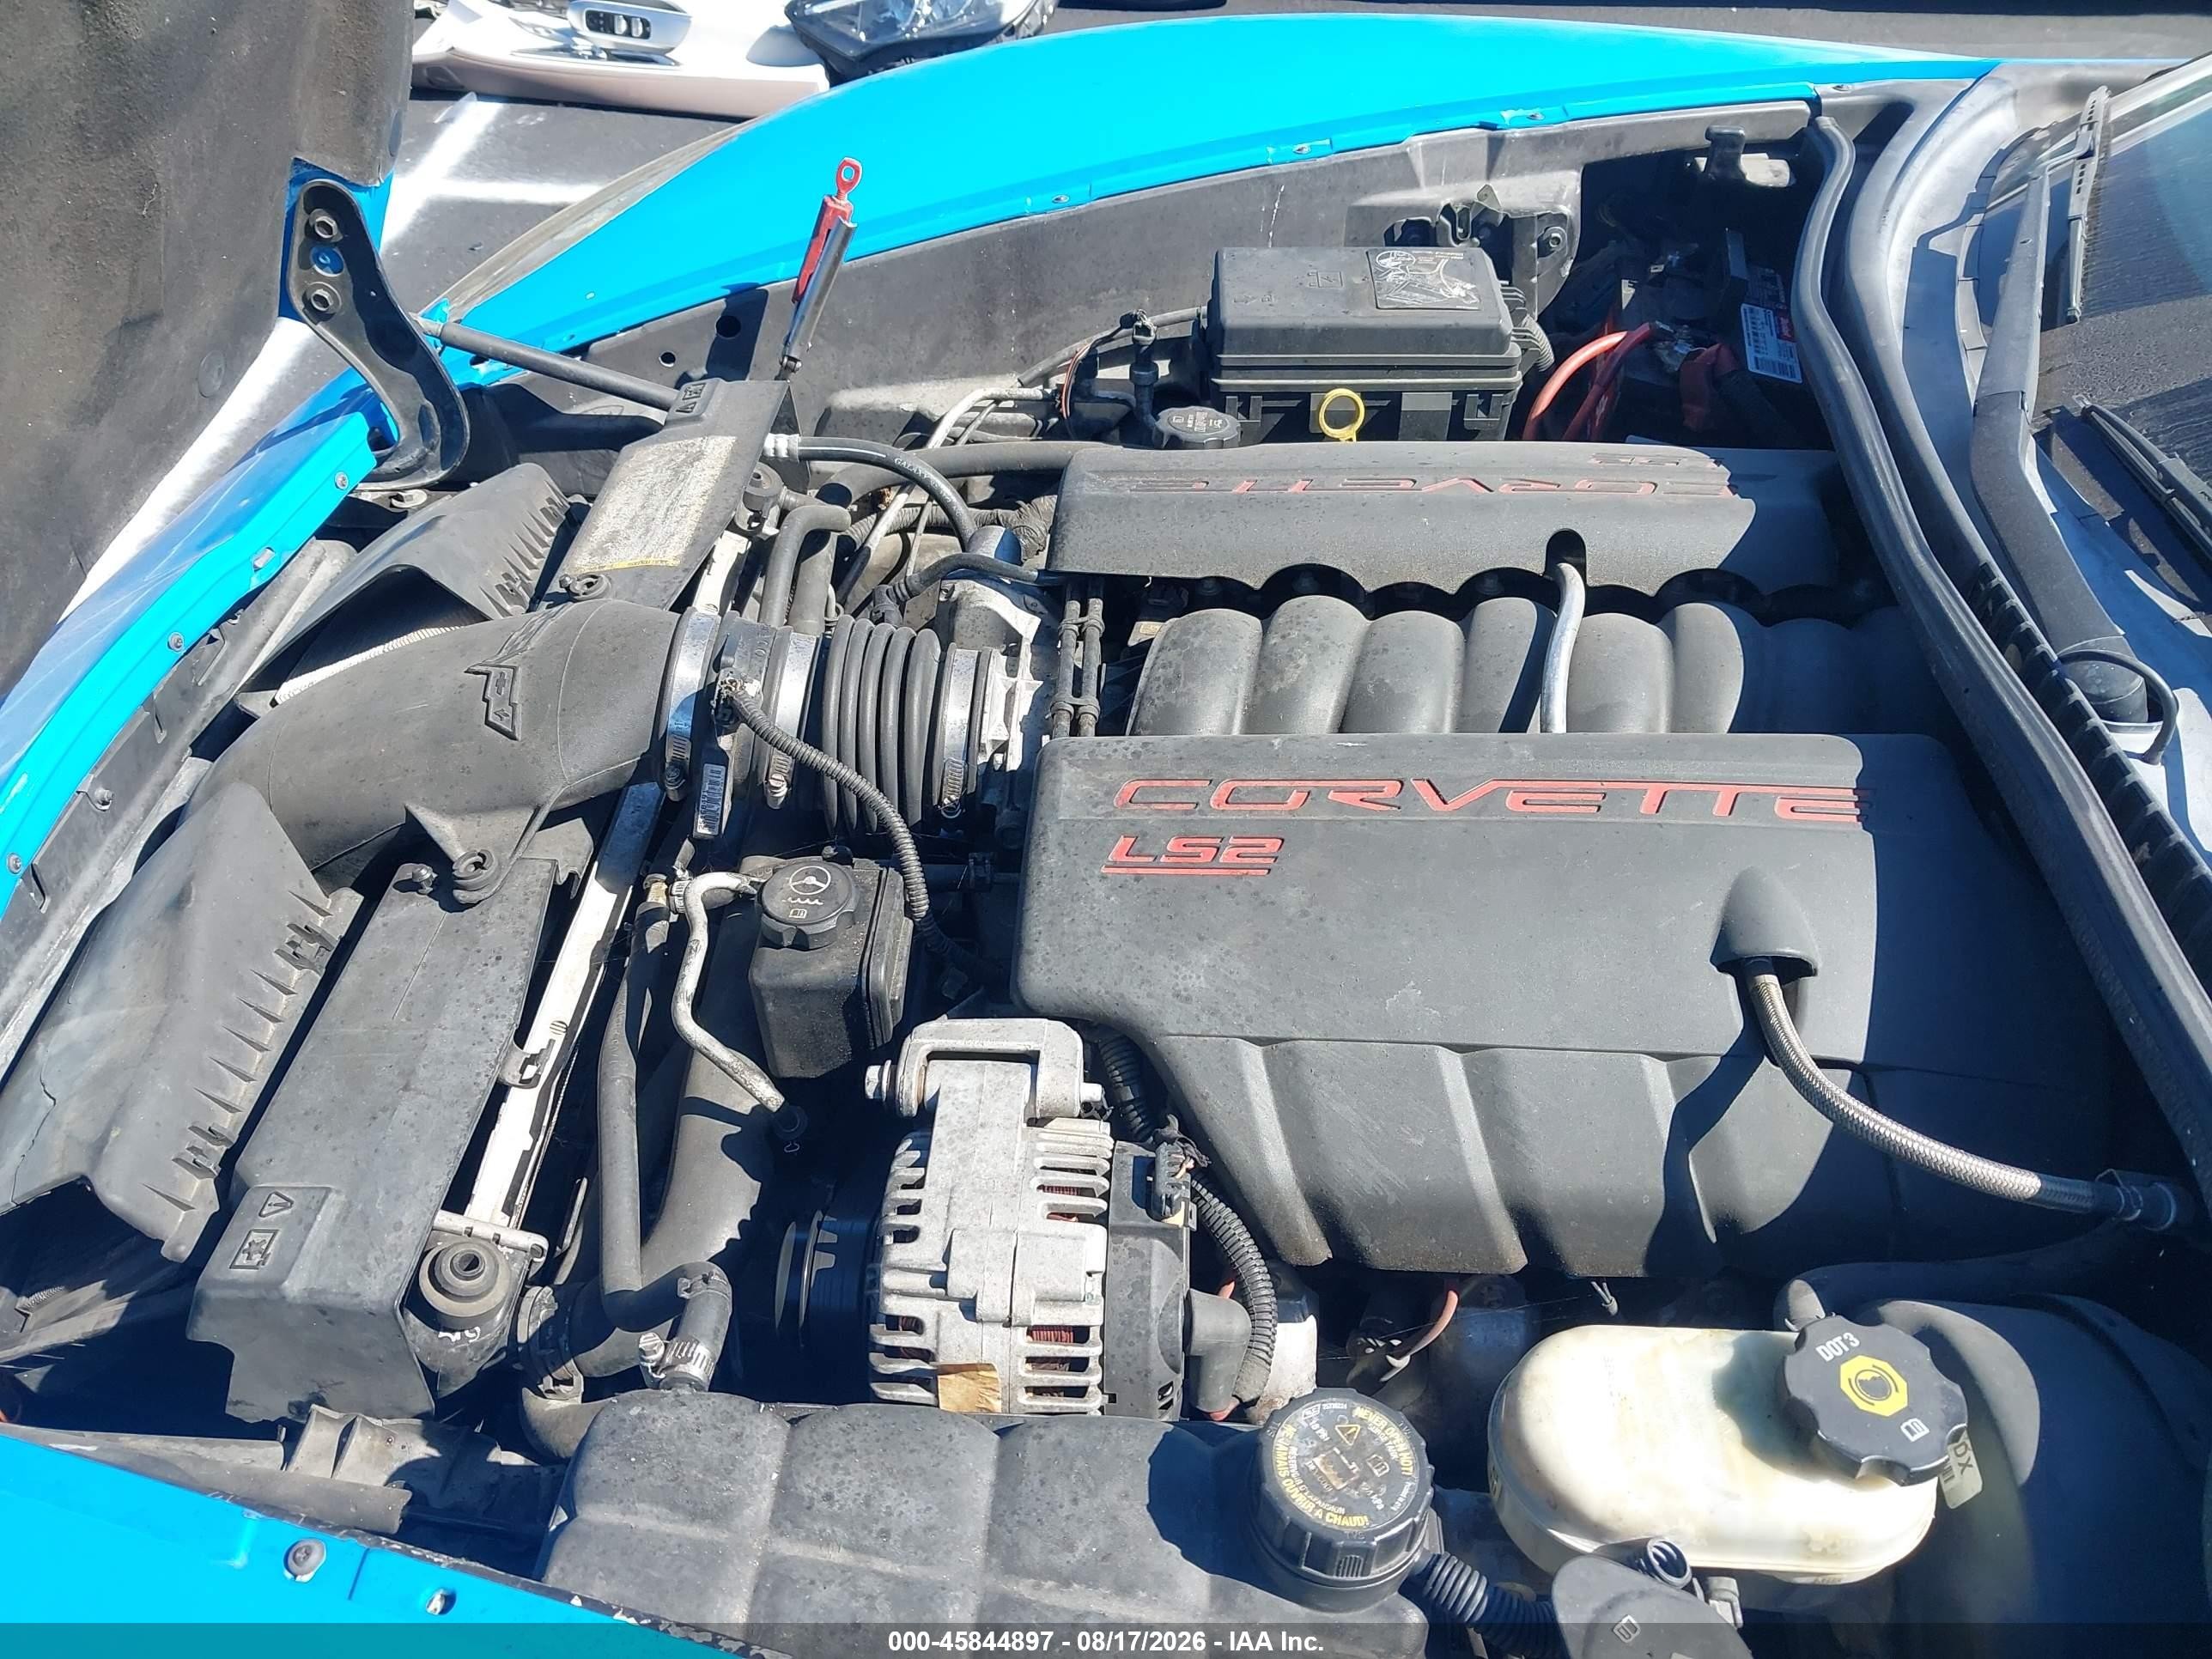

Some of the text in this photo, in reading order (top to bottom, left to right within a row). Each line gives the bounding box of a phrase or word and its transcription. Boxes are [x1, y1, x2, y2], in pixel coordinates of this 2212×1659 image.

[1113, 778, 1871, 823] CORVETTE
[1106, 834, 1286, 865] LS2
[1815, 1332, 1861, 1363] DOT 3
[1275, 1437, 1291, 1478] JAMAIS
[1352, 1406, 1414, 1476] NEVER OPEN HOT!
[1953, 1441, 1973, 1475] DX
[1281, 1478, 1316, 1513] OUVRIR
[1325, 1511, 1370, 1527] CHAUD!
